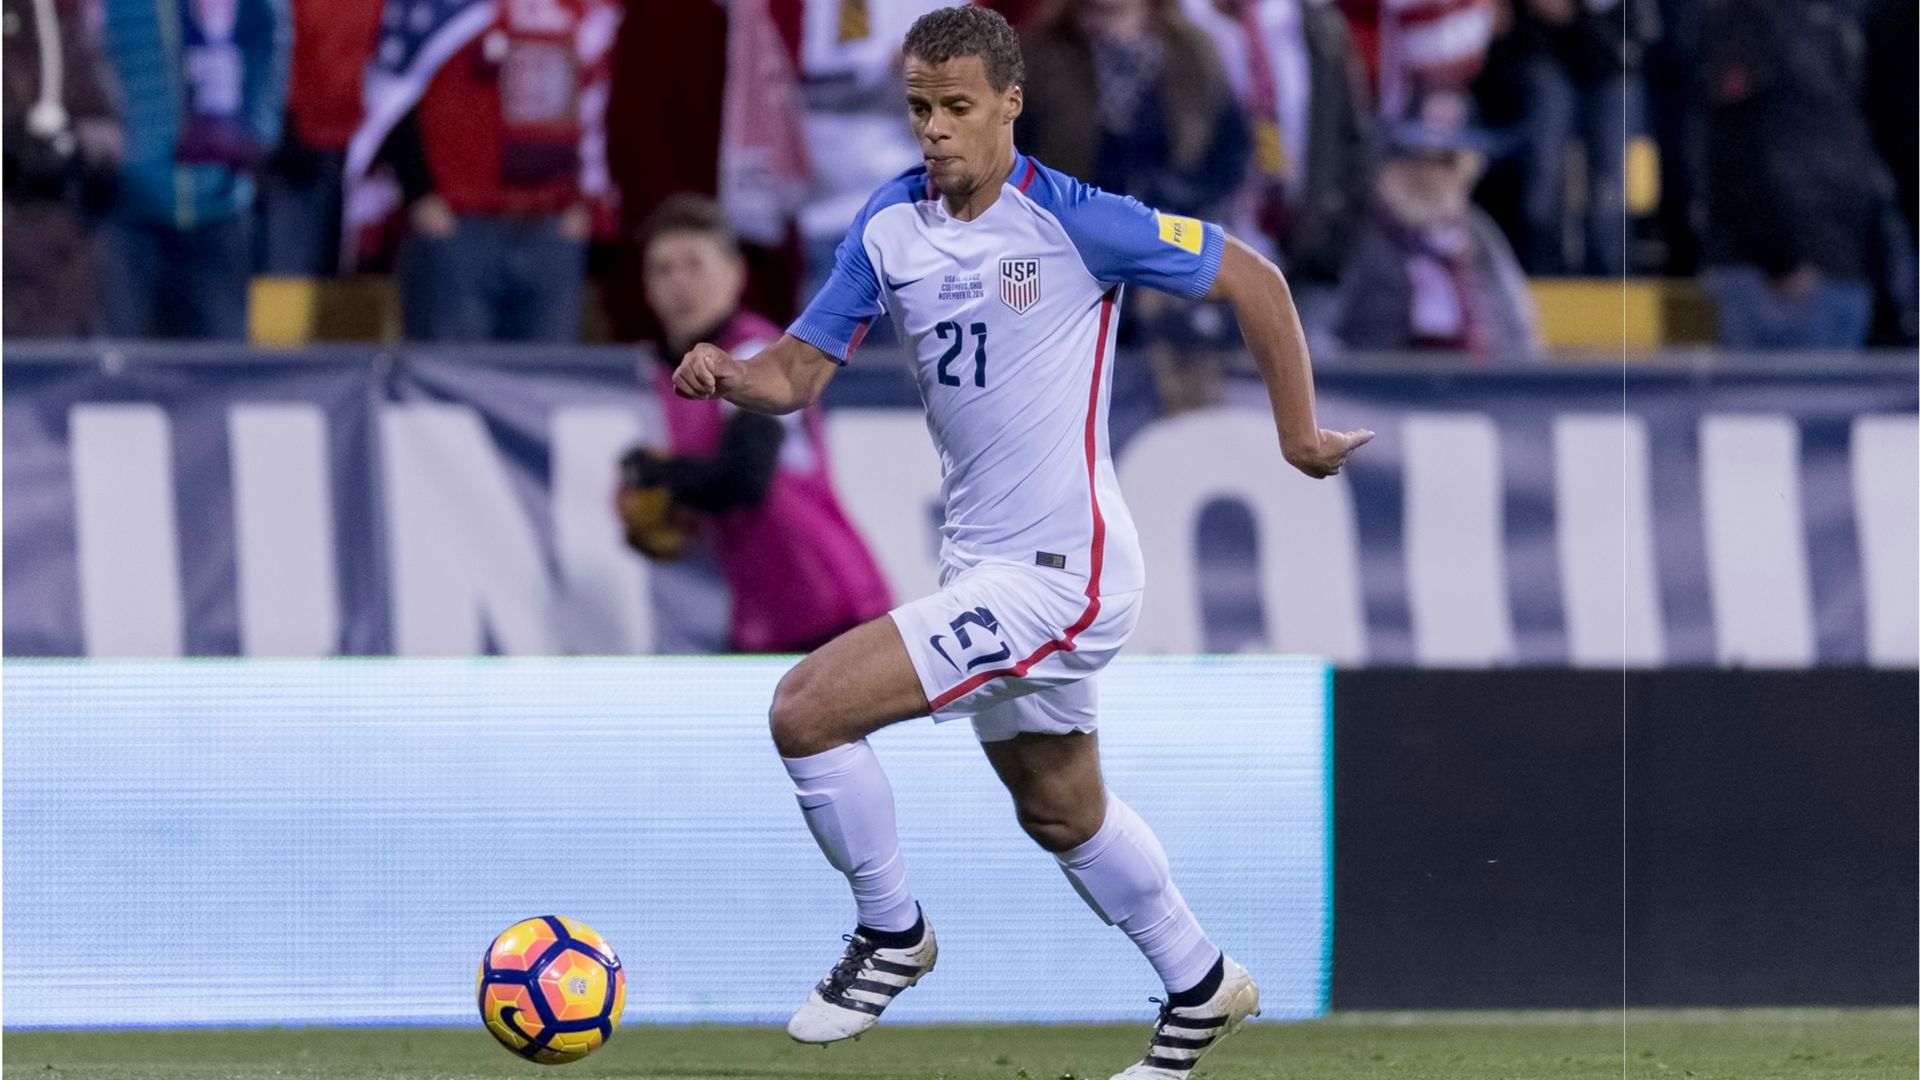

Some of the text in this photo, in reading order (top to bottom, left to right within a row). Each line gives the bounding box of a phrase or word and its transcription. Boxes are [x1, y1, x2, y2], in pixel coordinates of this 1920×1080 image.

[1173, 222, 1182, 243] FIFA
[1002, 261, 1037, 282] USA
[938, 291, 966, 300] NOVEMBER
[934, 320, 987, 388] 21
[949, 606, 1011, 672] 21
